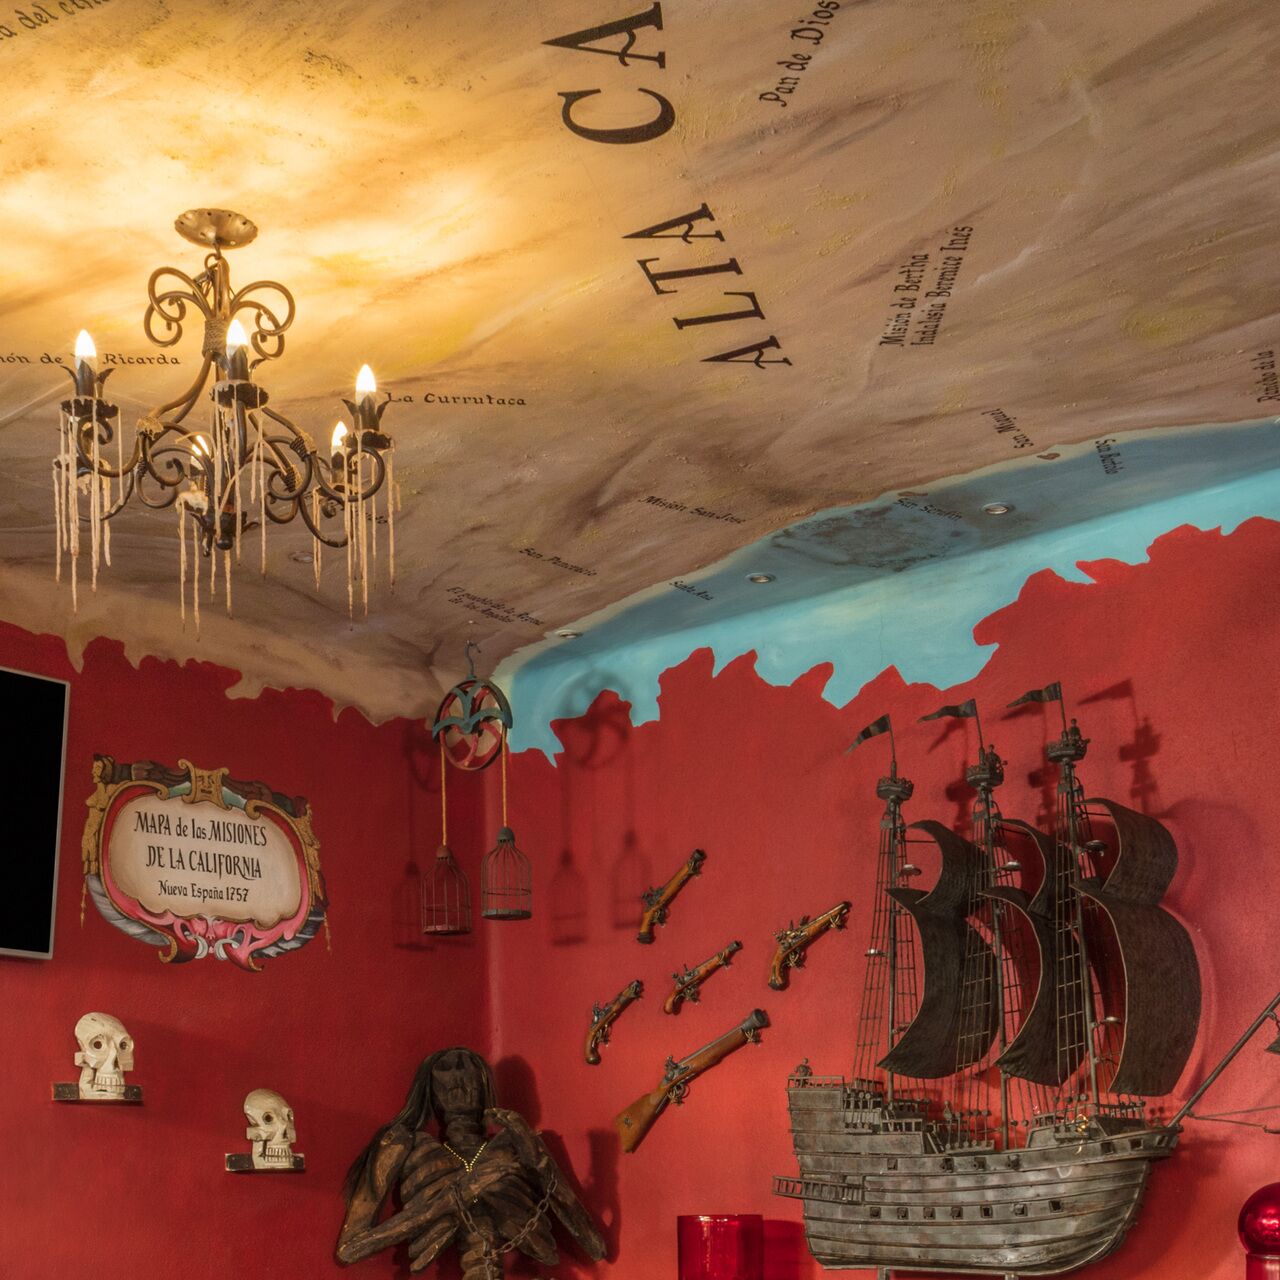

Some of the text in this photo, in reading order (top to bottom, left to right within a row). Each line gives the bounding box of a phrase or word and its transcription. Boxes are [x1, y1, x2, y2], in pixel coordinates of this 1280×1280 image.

[14, 5, 59, 30] del
[540, 0, 676, 144] CA
[758, 0, 840, 108] Pan de Dios
[621, 202, 793, 369] ALTA
[894, 253, 929, 292] Bertha
[890, 297, 918, 309] de
[40, 352, 64, 365] de
[102, 353, 181, 366] Ricarda
[385, 392, 528, 406] La Currutaca
[133, 811, 267, 847] MAPA de las MISIONES
[146, 845, 262, 881] DE LA CALIFORNIA
[158, 879, 249, 903] Nueva España 1757
